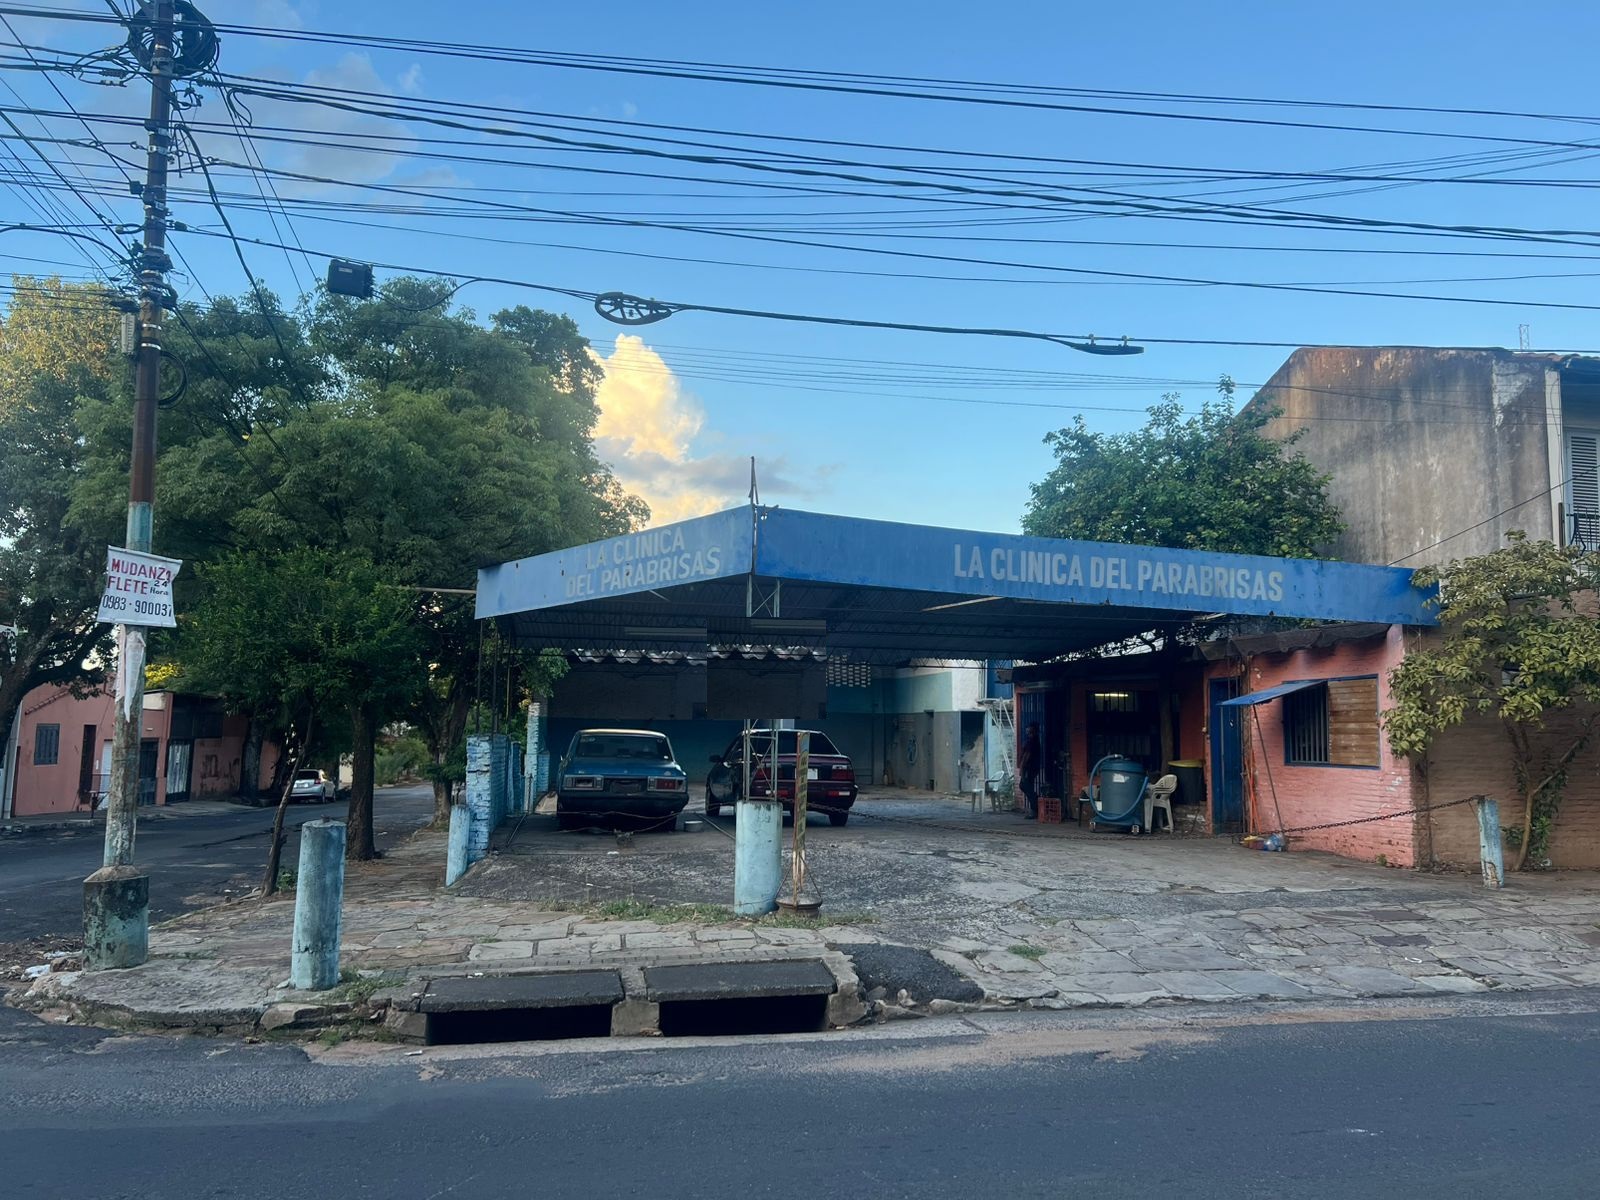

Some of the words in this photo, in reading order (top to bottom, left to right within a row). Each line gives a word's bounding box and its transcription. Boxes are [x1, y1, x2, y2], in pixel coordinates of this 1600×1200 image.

[587, 549, 607, 570] LA
[613, 526, 685, 565] CLINICA
[107, 576, 148, 595] FLETE
[565, 574, 594, 598] DEL
[601, 547, 721, 592] PARABRISAS
[954, 544, 985, 579] LA
[990, 548, 1084, 587] CLINICA
[1090, 556, 1132, 590] DEL
[1138, 560, 1283, 601] PARABRISAS
